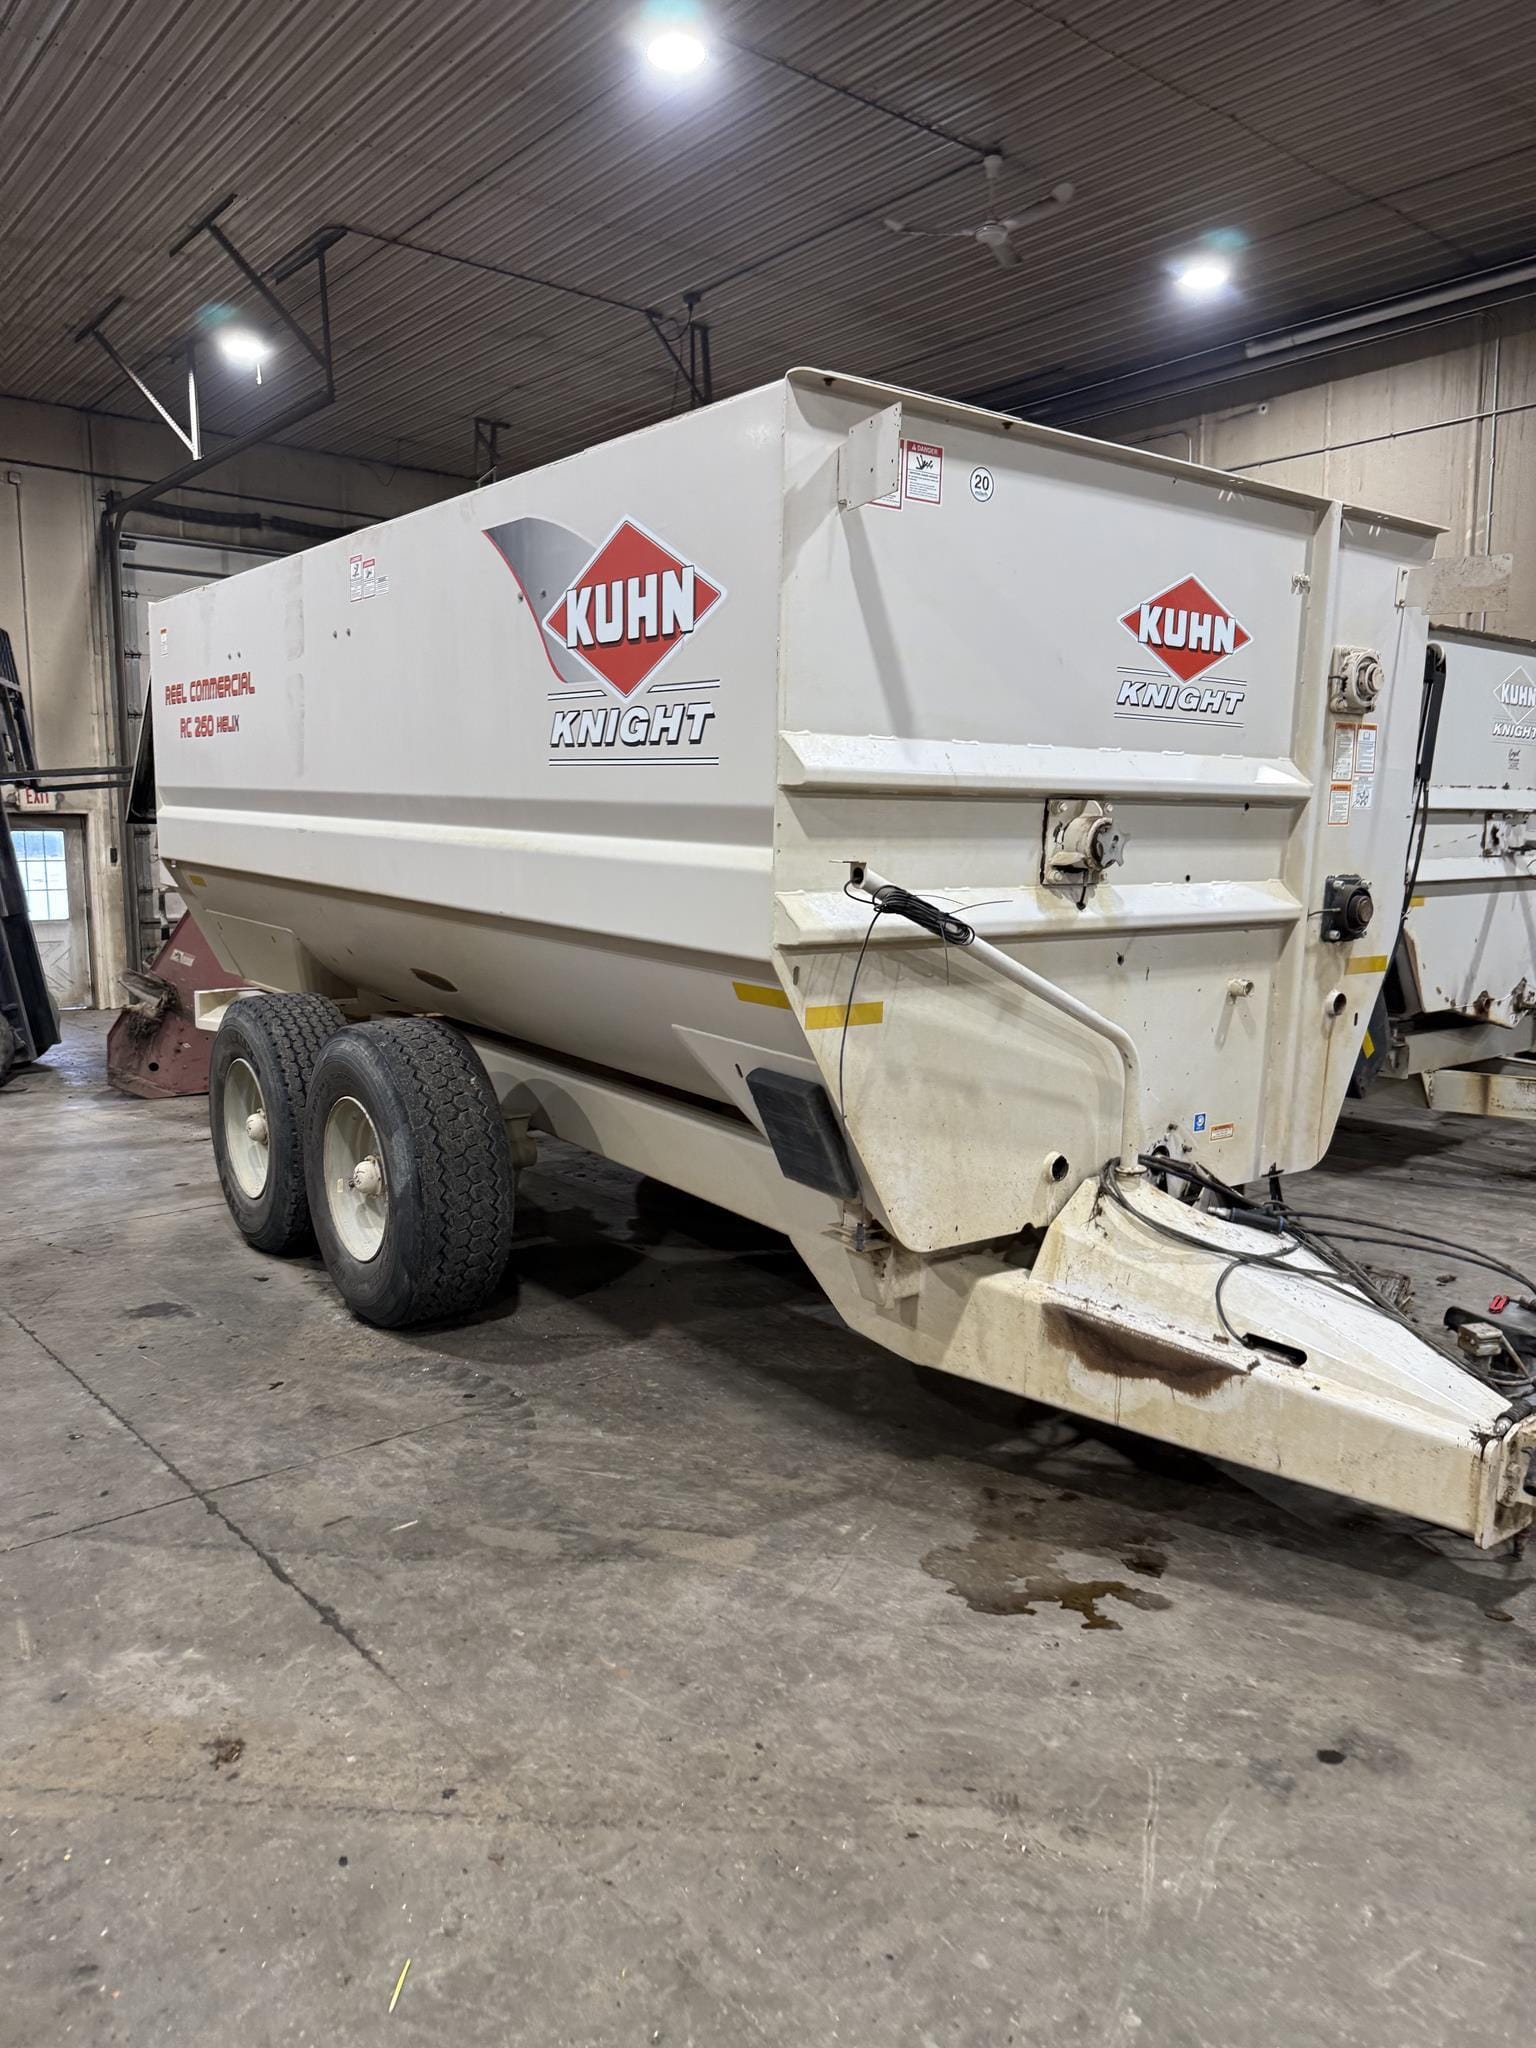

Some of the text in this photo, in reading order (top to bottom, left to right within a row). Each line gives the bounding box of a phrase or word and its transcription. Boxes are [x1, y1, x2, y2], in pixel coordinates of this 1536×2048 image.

[974, 474, 989, 490] 20
[566, 565, 695, 650] KUHN
[1138, 603, 1236, 655] KUHN
[165, 672, 255, 705] REEL COMMERCIAL
[1116, 680, 1245, 715] KNIGHT
[1501, 683, 1536, 708] KUHN
[180, 714, 240, 738] RC 260 HELIX
[550, 701, 716, 748] KNIGHT
